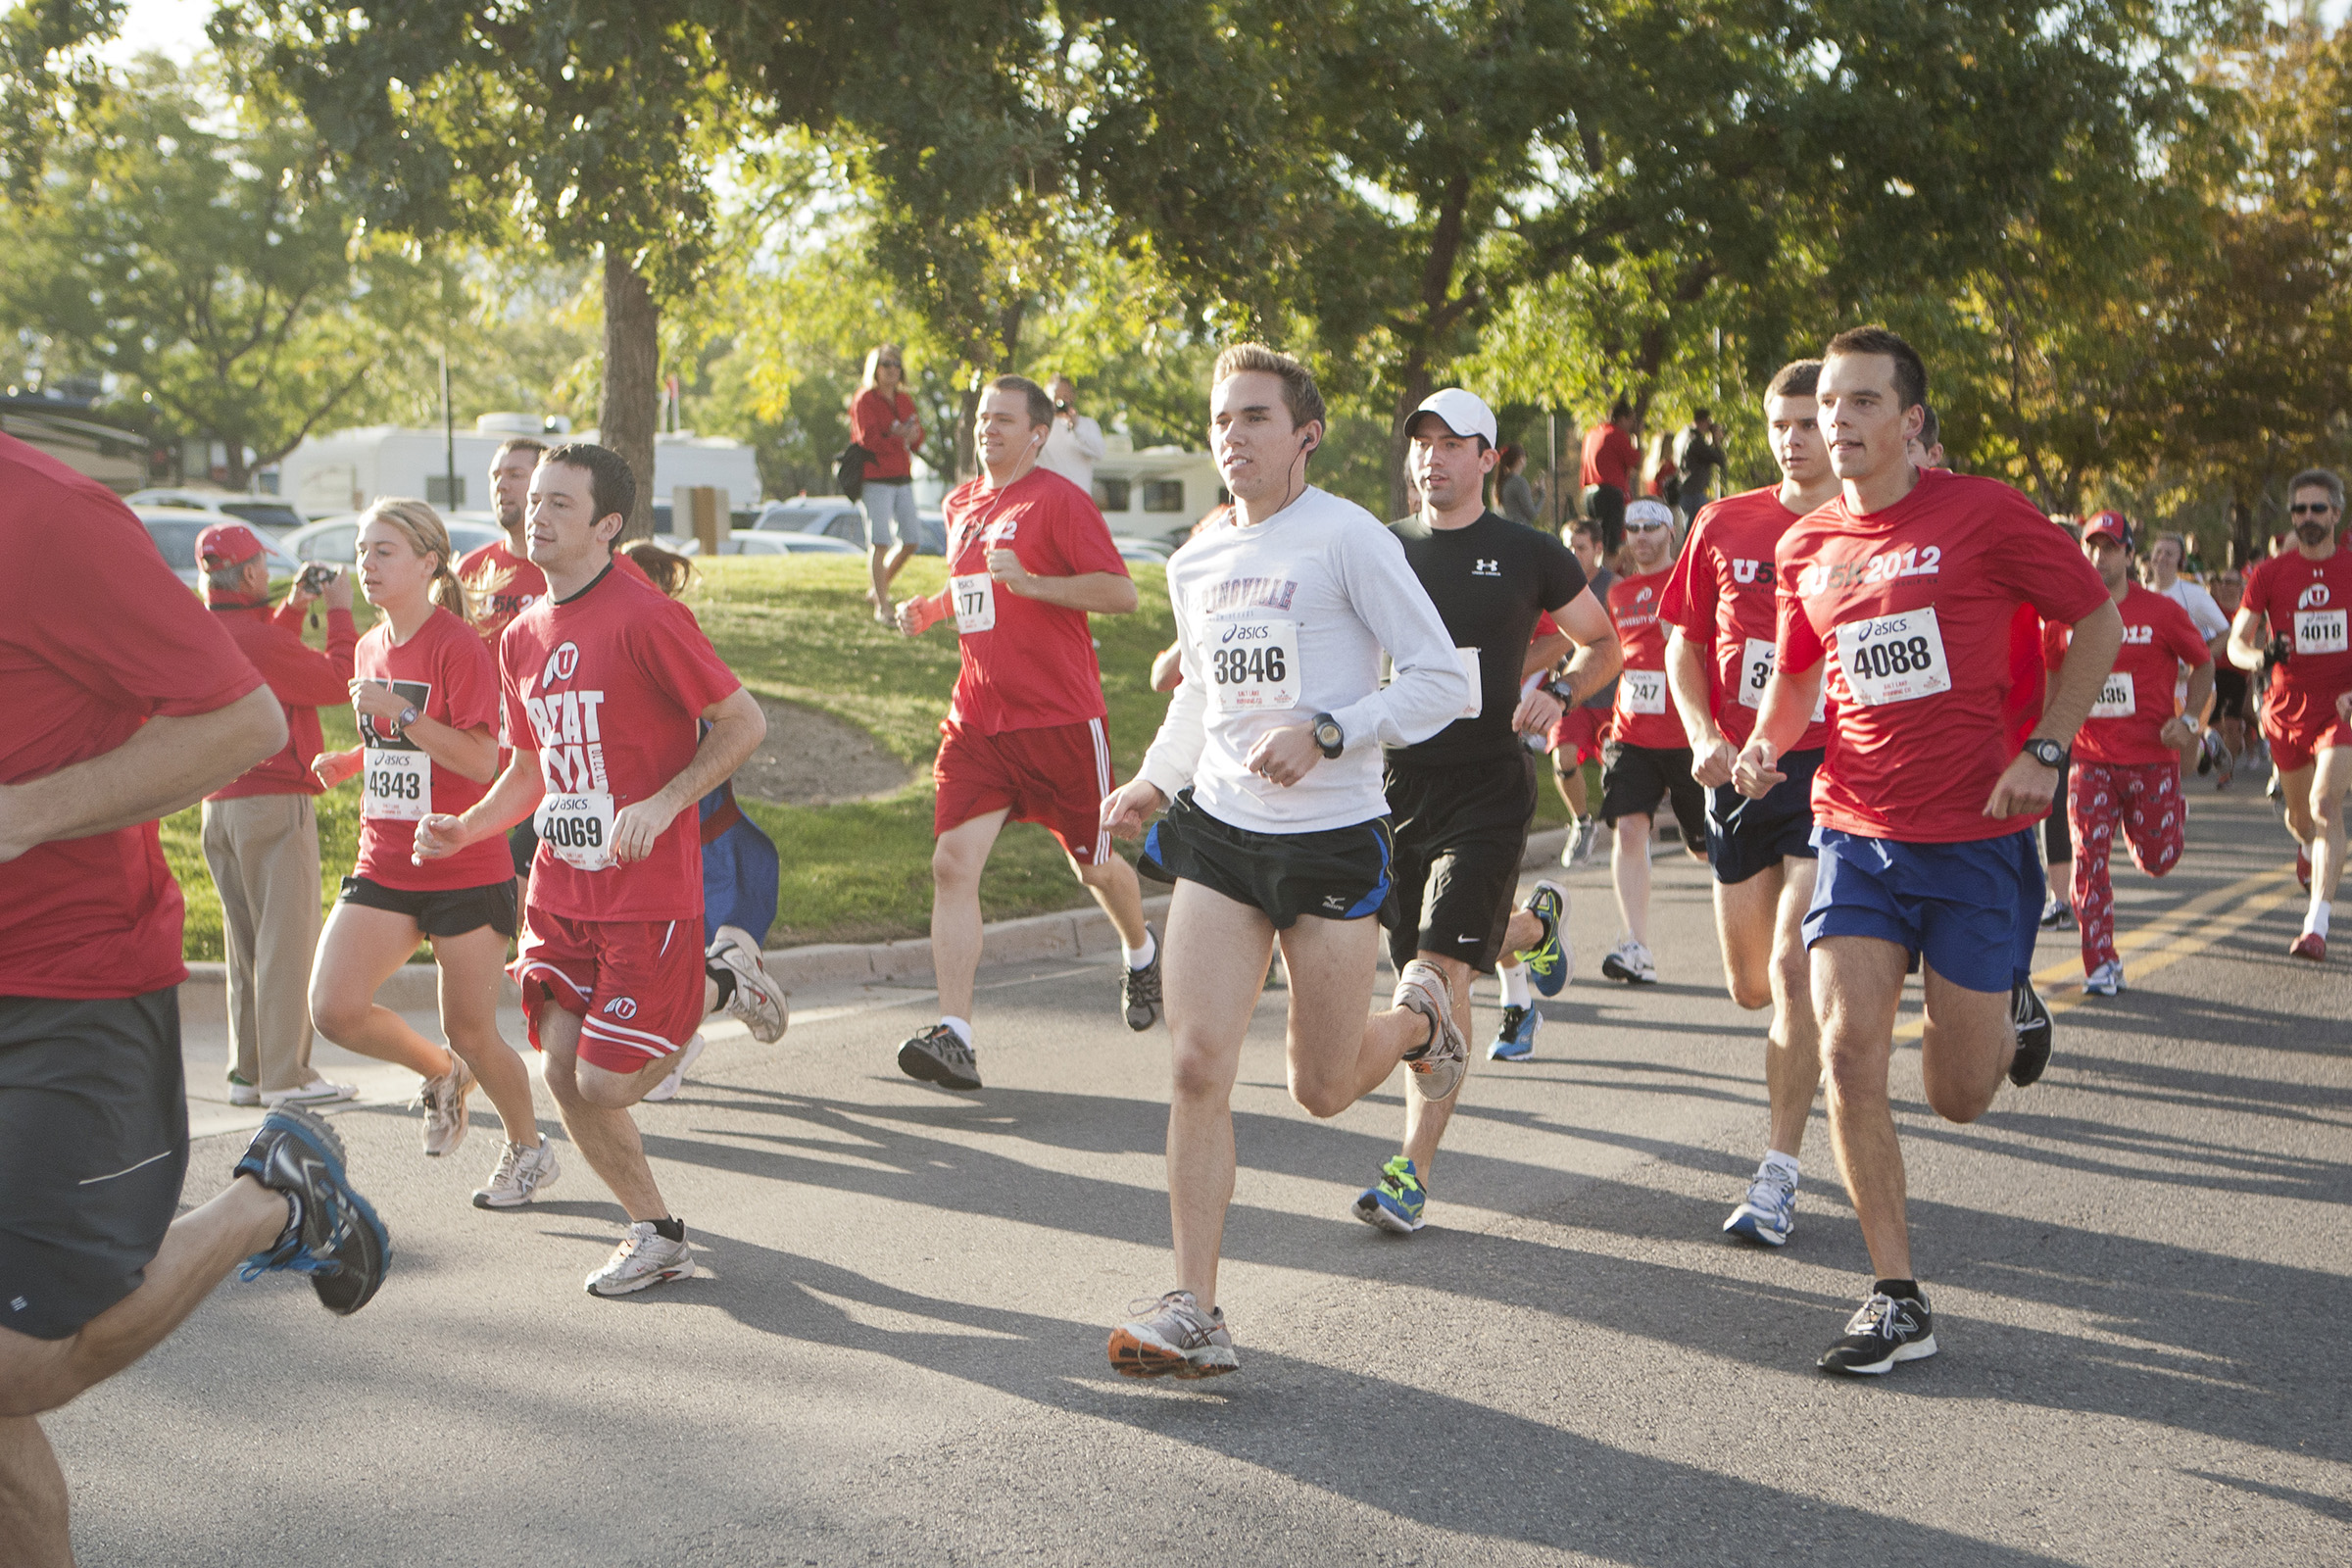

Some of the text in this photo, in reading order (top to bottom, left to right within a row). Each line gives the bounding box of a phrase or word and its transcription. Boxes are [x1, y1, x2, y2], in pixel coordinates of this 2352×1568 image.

[1732, 558, 1776, 584] U5
[1808, 546, 1941, 596] U5K2012
[481, 594, 544, 613] 5K2
[2301, 623, 2341, 641] 4018
[558, 649, 575, 674] U
[1213, 646, 1286, 684] 3846
[1853, 636, 1933, 680] 4088
[1750, 662, 1774, 689] 3
[1632, 683, 1659, 701] 247
[526, 690, 605, 748] BEAT
[369, 770, 420, 800] 4343
[543, 816, 604, 849] 4069
